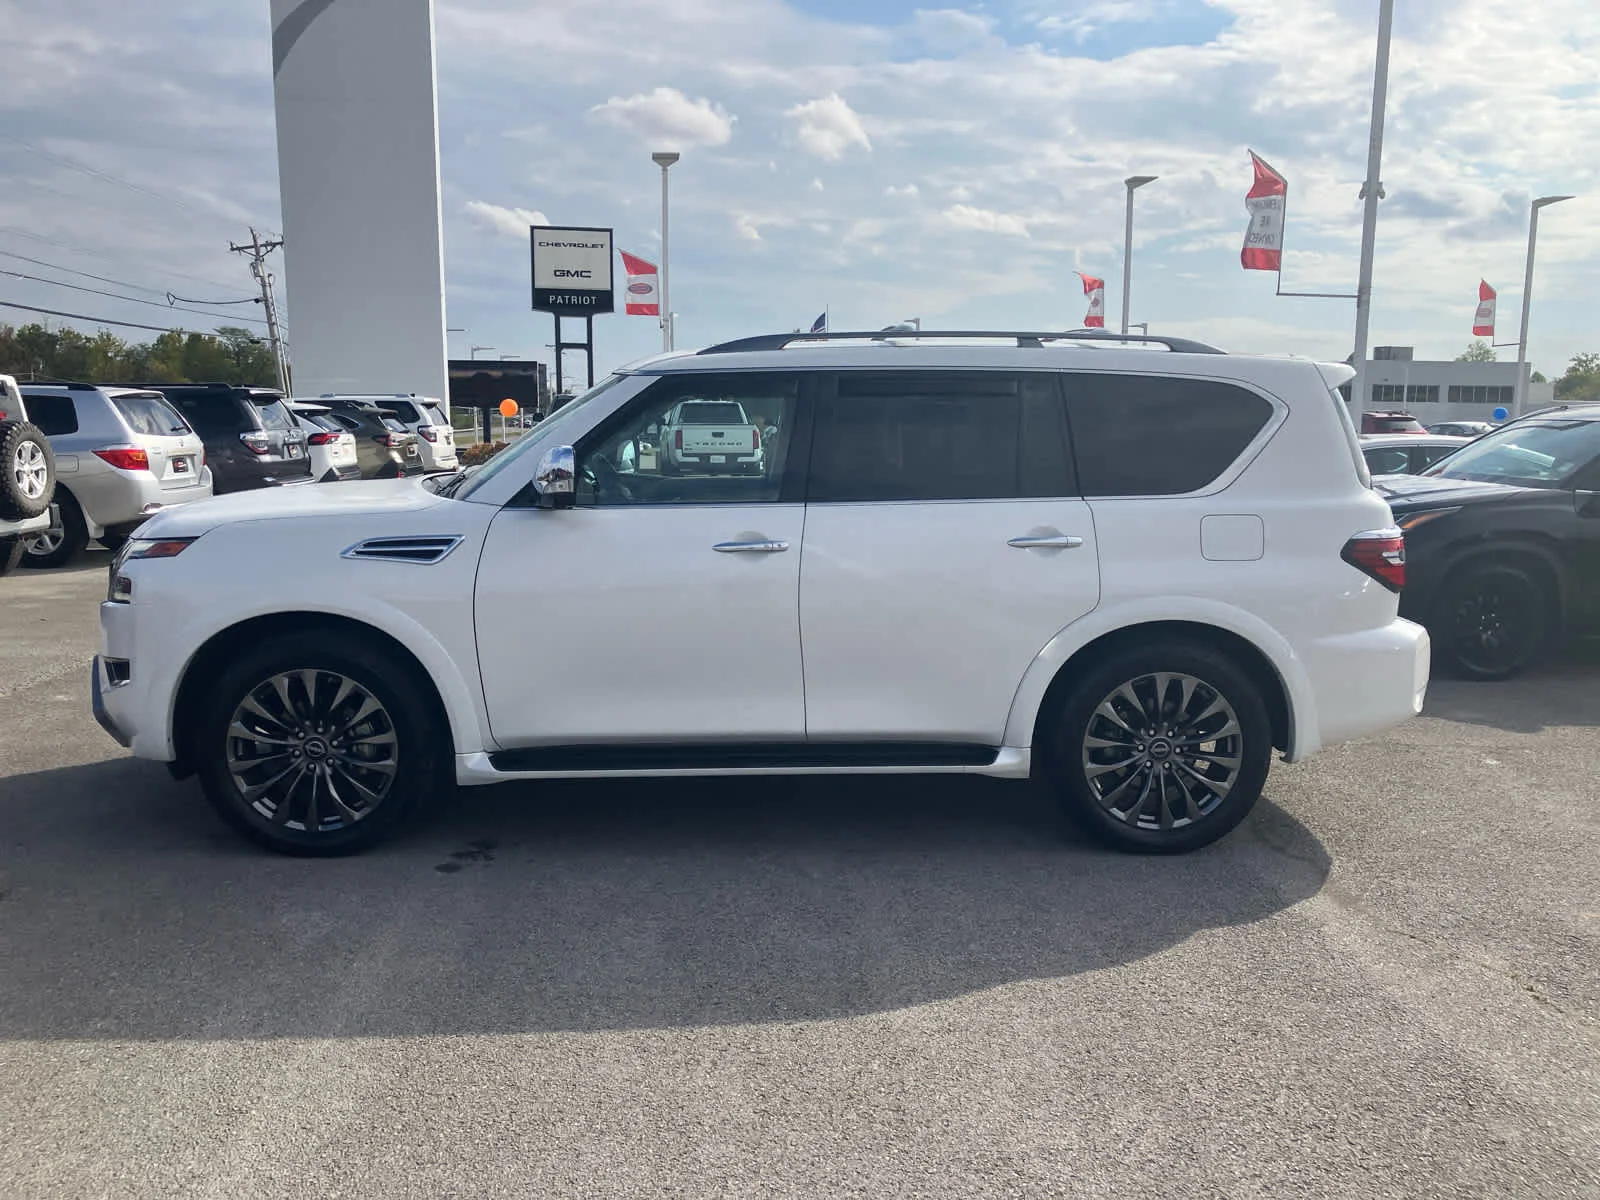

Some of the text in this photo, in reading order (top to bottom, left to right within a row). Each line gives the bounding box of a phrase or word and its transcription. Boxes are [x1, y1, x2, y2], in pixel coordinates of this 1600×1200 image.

[538, 241, 604, 249] CHEVROLET
[553, 269, 592, 278] GMC
[549, 295, 597, 305] PATRIOT
